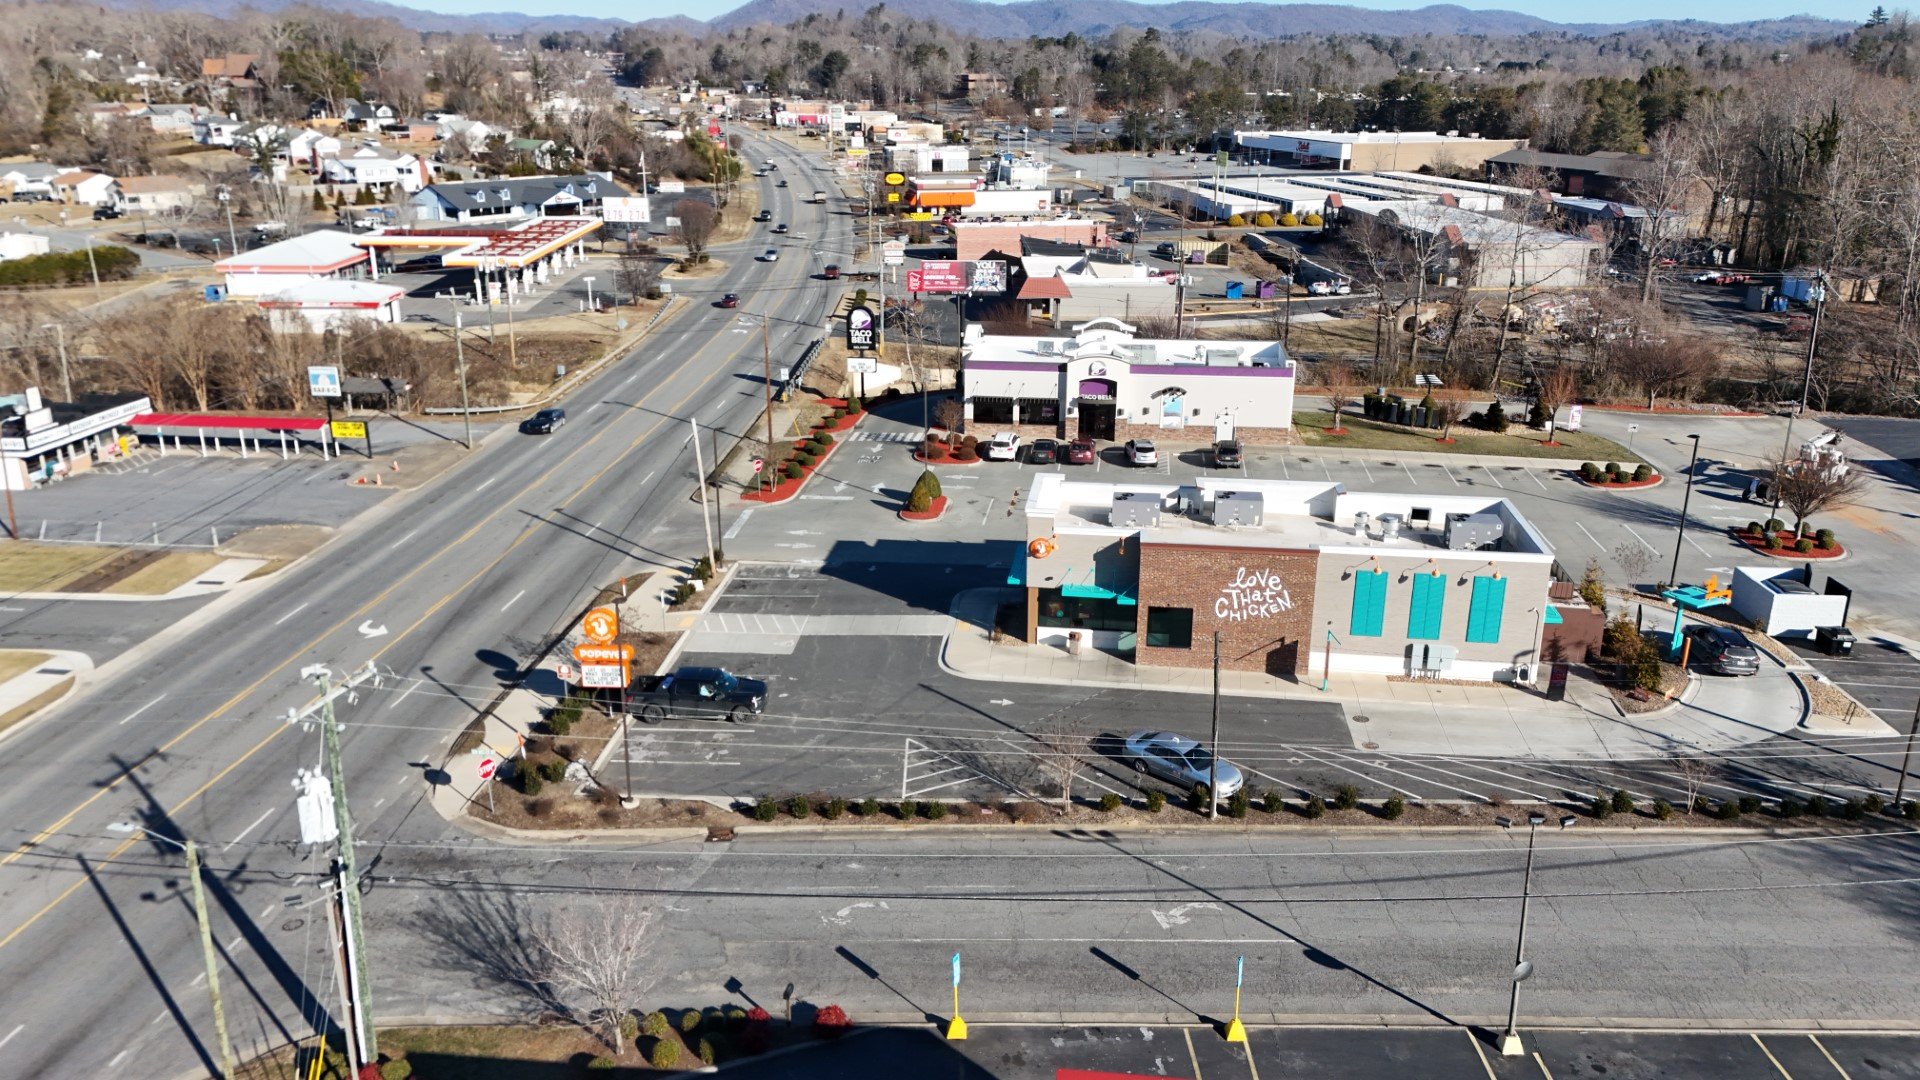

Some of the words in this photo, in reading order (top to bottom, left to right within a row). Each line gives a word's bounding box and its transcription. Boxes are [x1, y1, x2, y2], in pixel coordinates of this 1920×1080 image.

[851, 336, 872, 344] BELL
[579, 649, 628, 659] POPEYES
[479, 762, 494, 776] STOP
